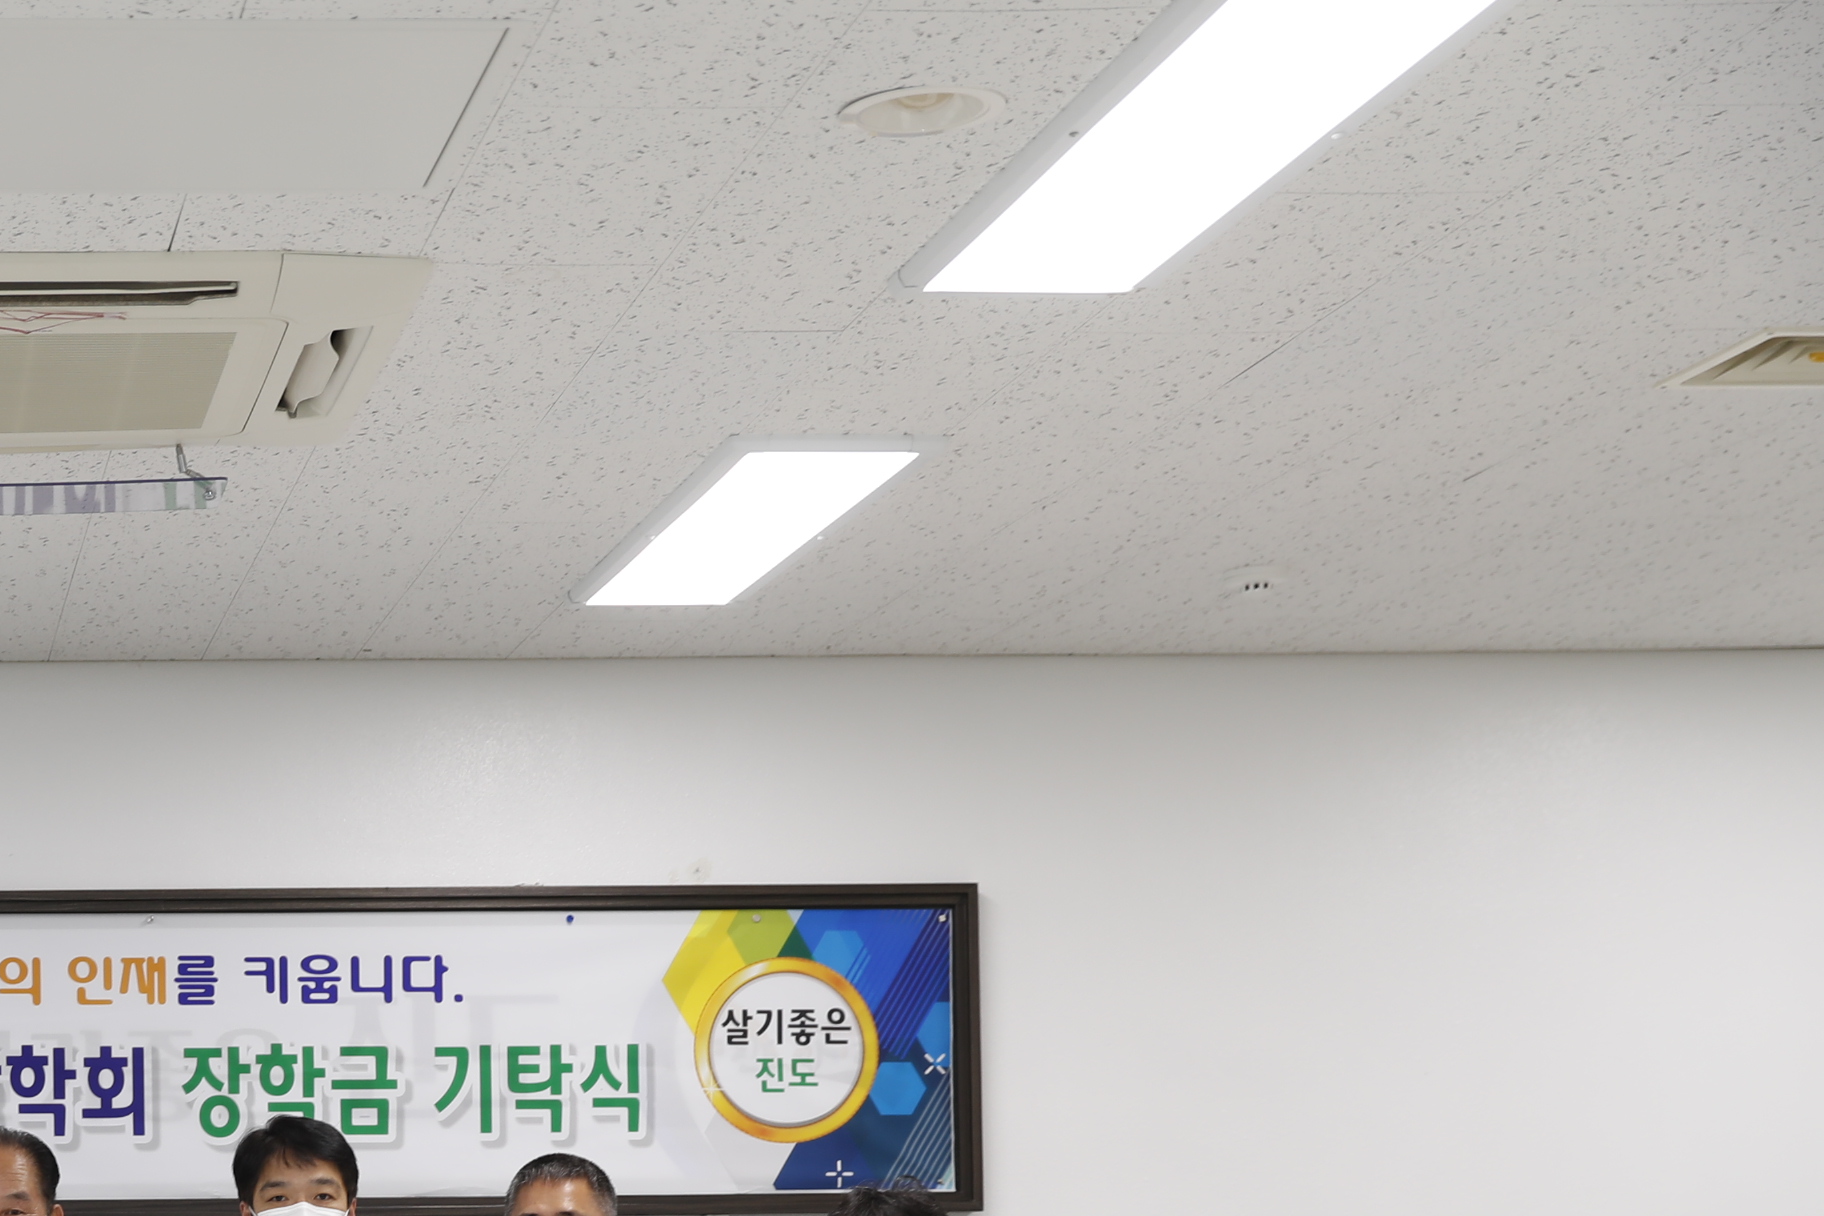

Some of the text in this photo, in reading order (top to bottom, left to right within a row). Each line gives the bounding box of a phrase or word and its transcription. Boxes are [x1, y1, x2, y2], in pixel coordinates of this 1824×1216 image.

[68, 956, 218, 1005] 인재를
[719, 1005, 854, 1046] 살기좋은
[182, 1044, 397, 1138] 장학금
[434, 1044, 640, 1133] 기탁식
[756, 1058, 818, 1093] 진도
